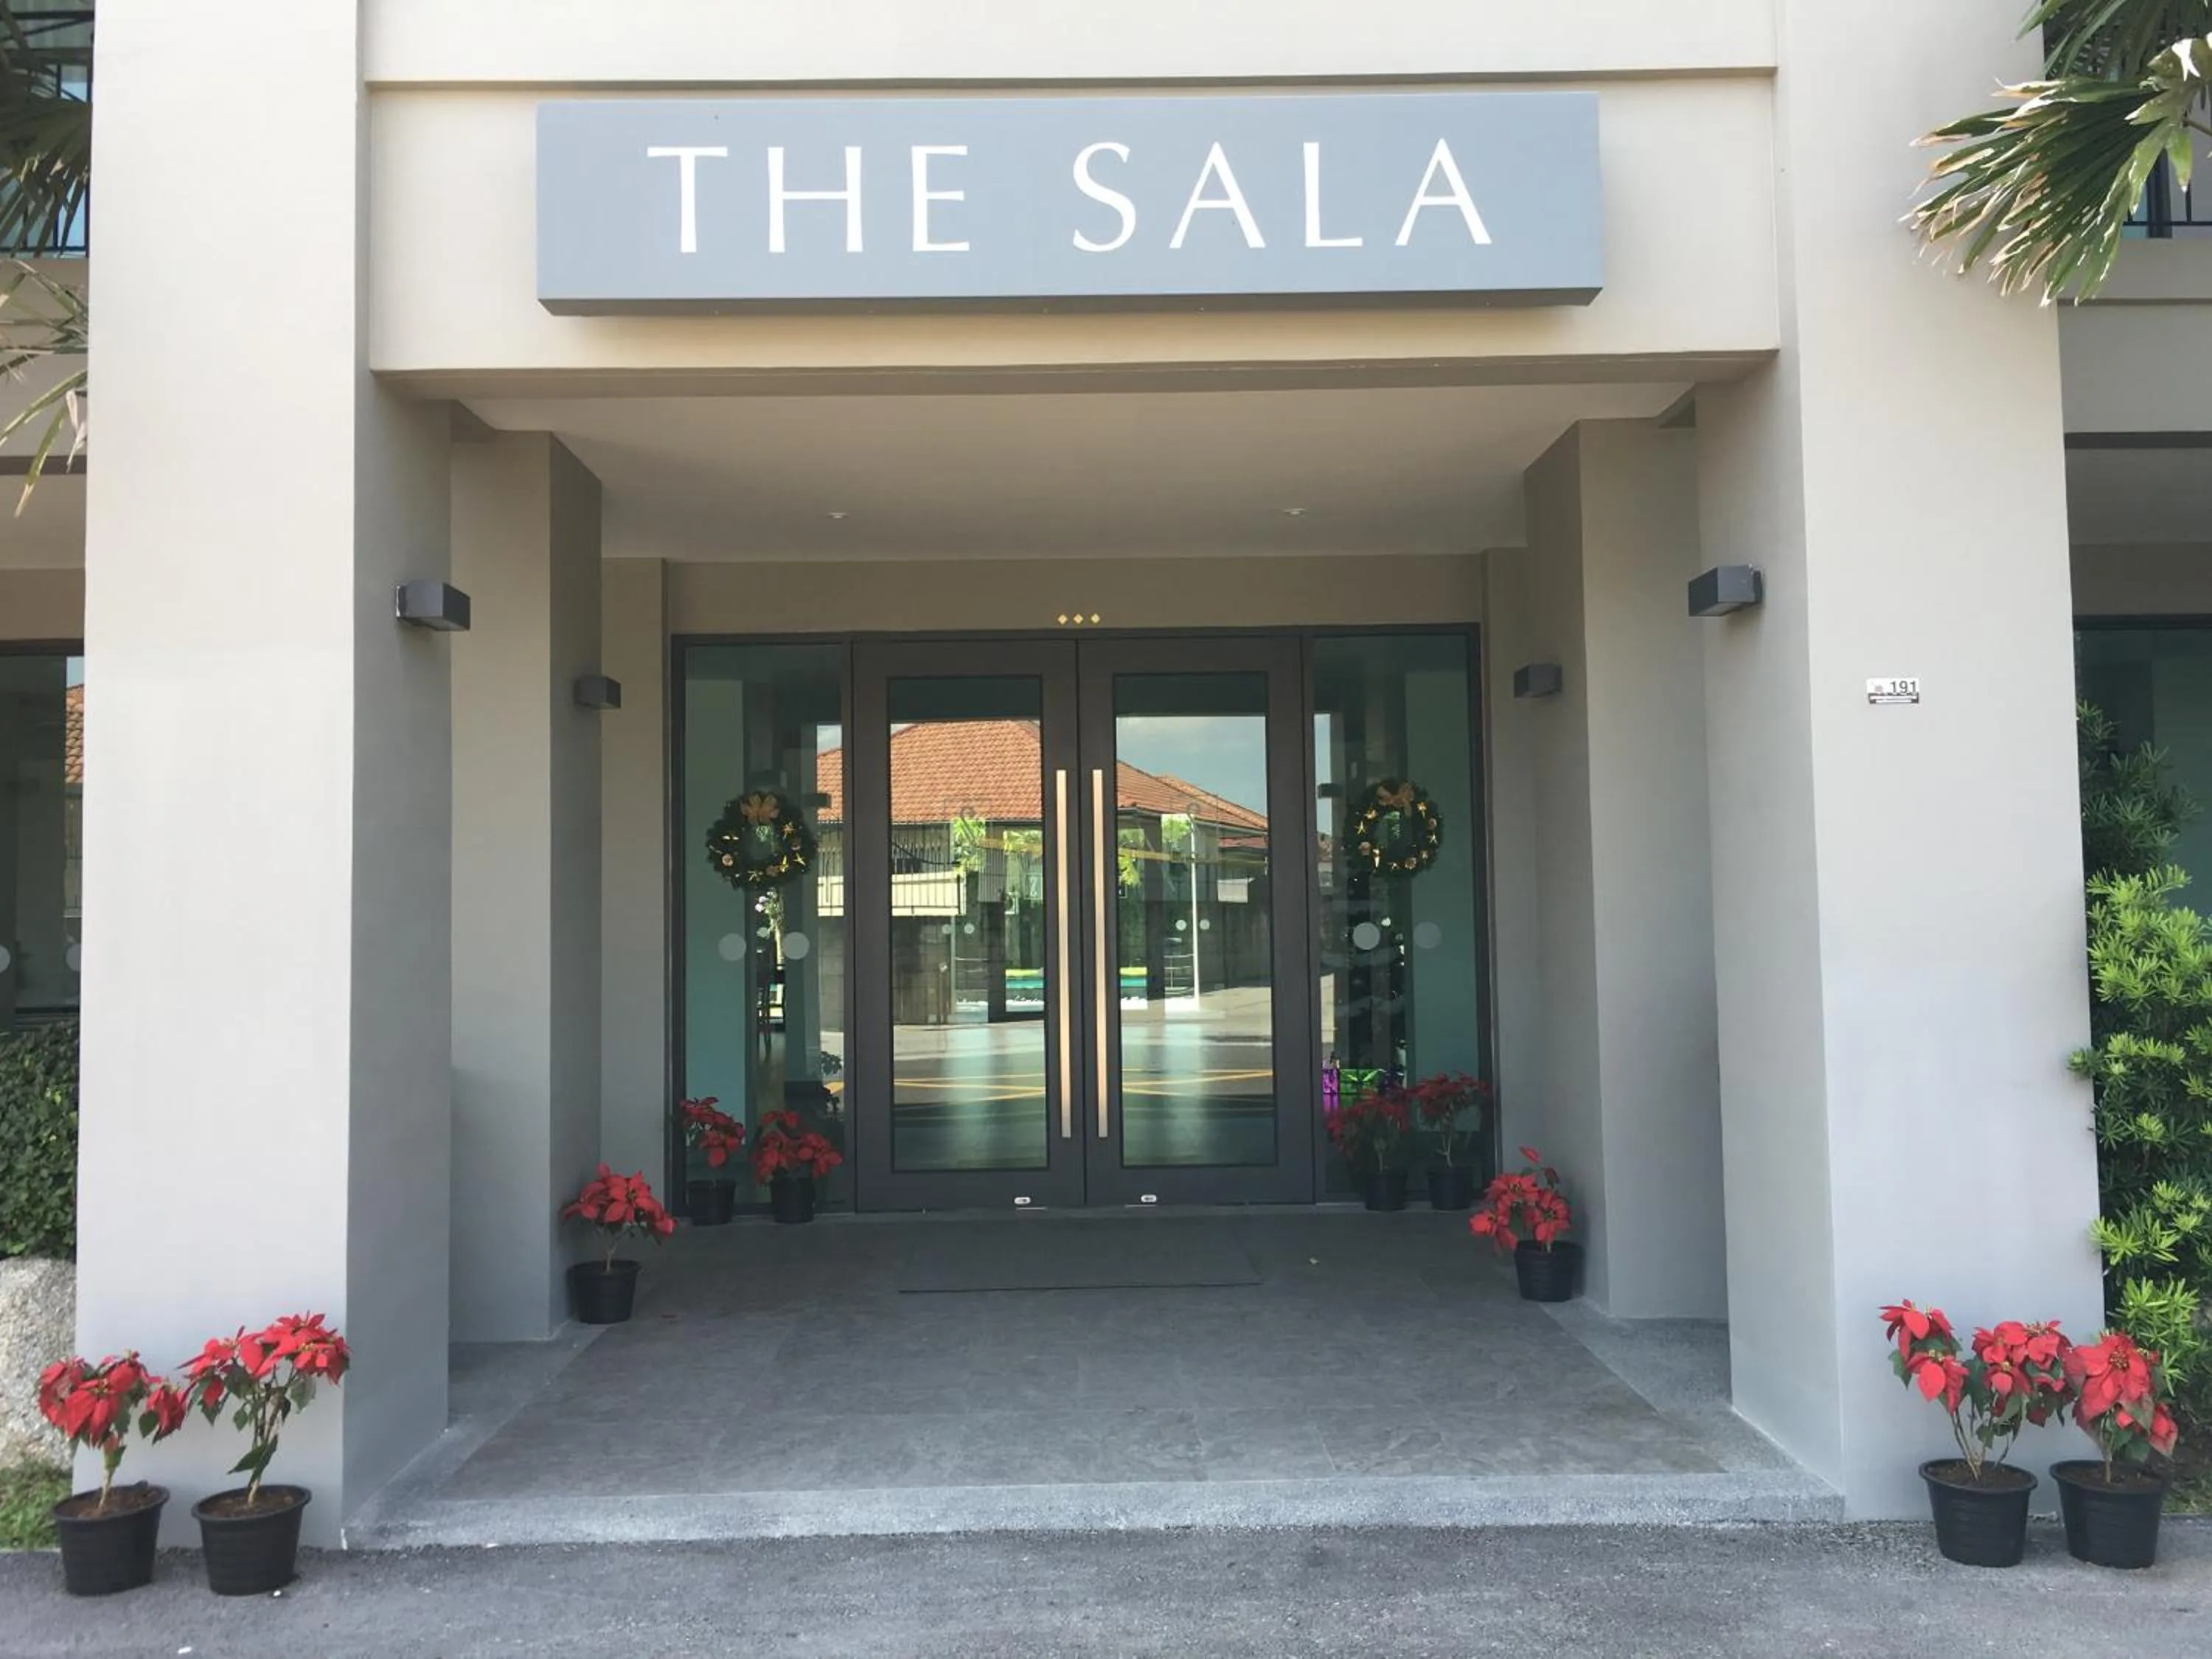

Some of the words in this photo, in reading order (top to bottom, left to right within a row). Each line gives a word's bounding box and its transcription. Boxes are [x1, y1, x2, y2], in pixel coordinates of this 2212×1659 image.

[647, 145, 970, 254] THE
[1072, 139, 1492, 252] SALA
[1889, 680, 1917, 694] 191
